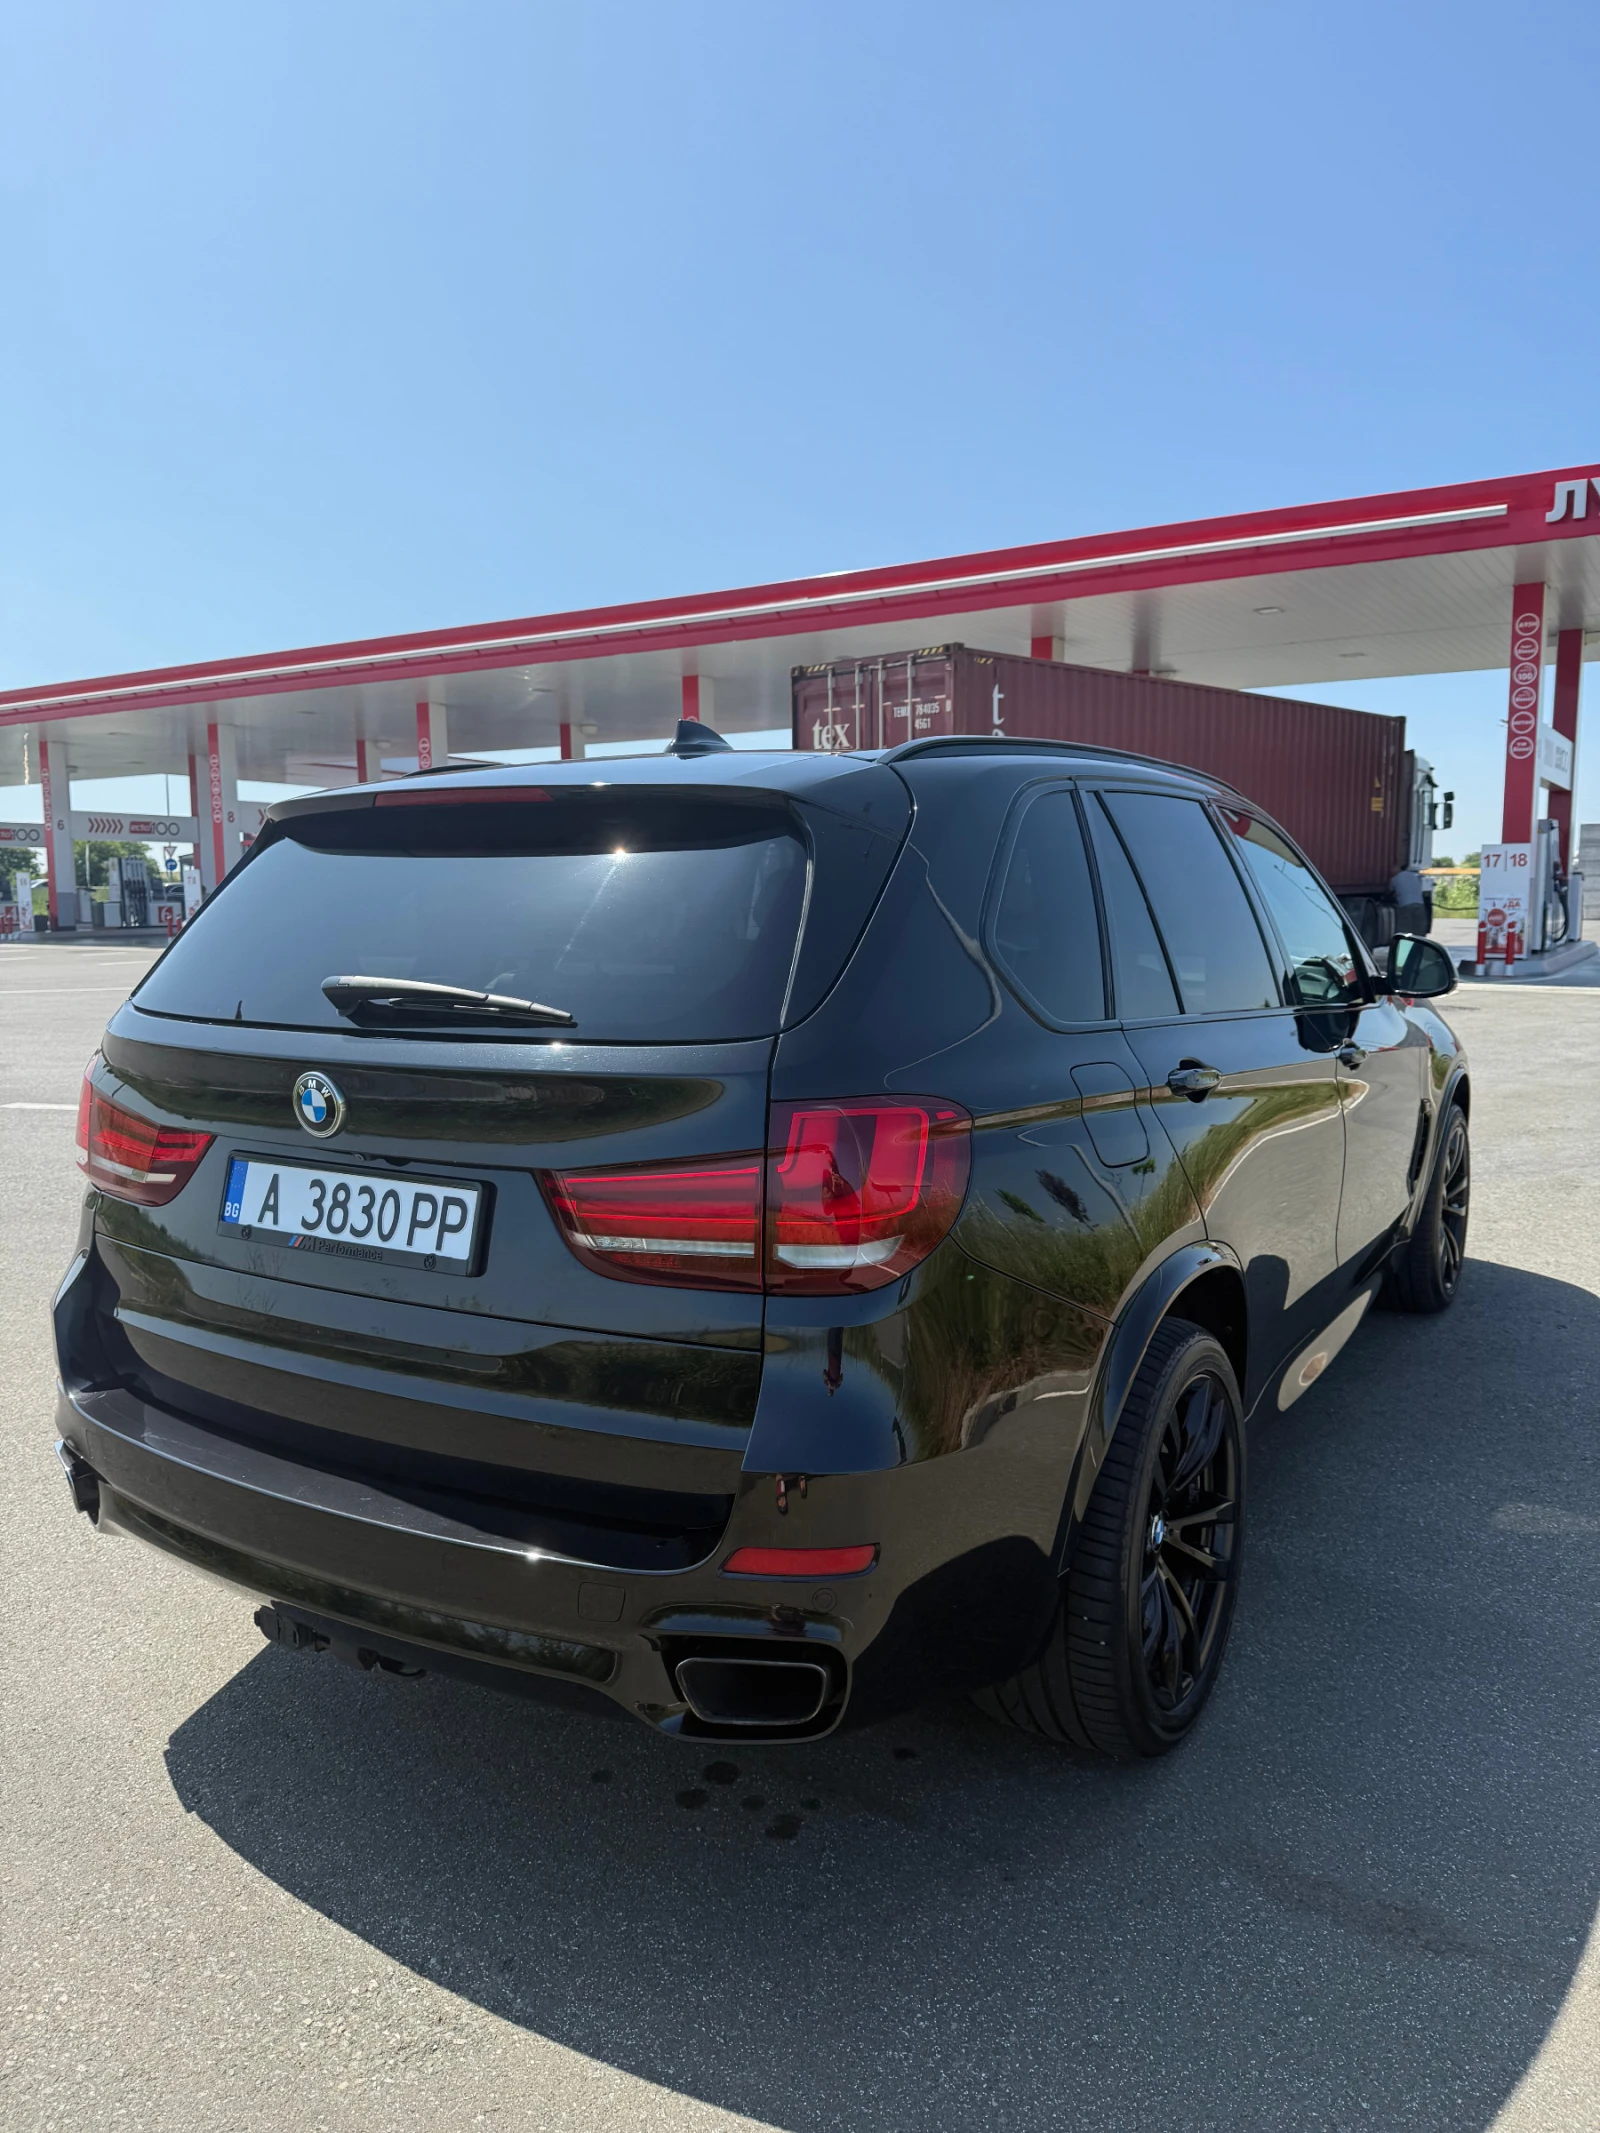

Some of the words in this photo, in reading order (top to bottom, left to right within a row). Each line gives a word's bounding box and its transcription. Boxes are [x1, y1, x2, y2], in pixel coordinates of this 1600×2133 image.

[1545, 477, 1600, 523] Л
[812, 718, 852, 750] tex
[57, 819, 65, 830] 6
[227, 811, 235, 823] 8
[1484, 854, 1501, 868] 17
[1510, 853, 1528, 867] 18
[299, 1079, 331, 1098] BMW
[224, 1201, 240, 1218] BG
[257, 1173, 279, 1226] A
[300, 1178, 400, 1242] 3830
[406, 1192, 468, 1251] PP
[318, 1240, 382, 1261] Performance
